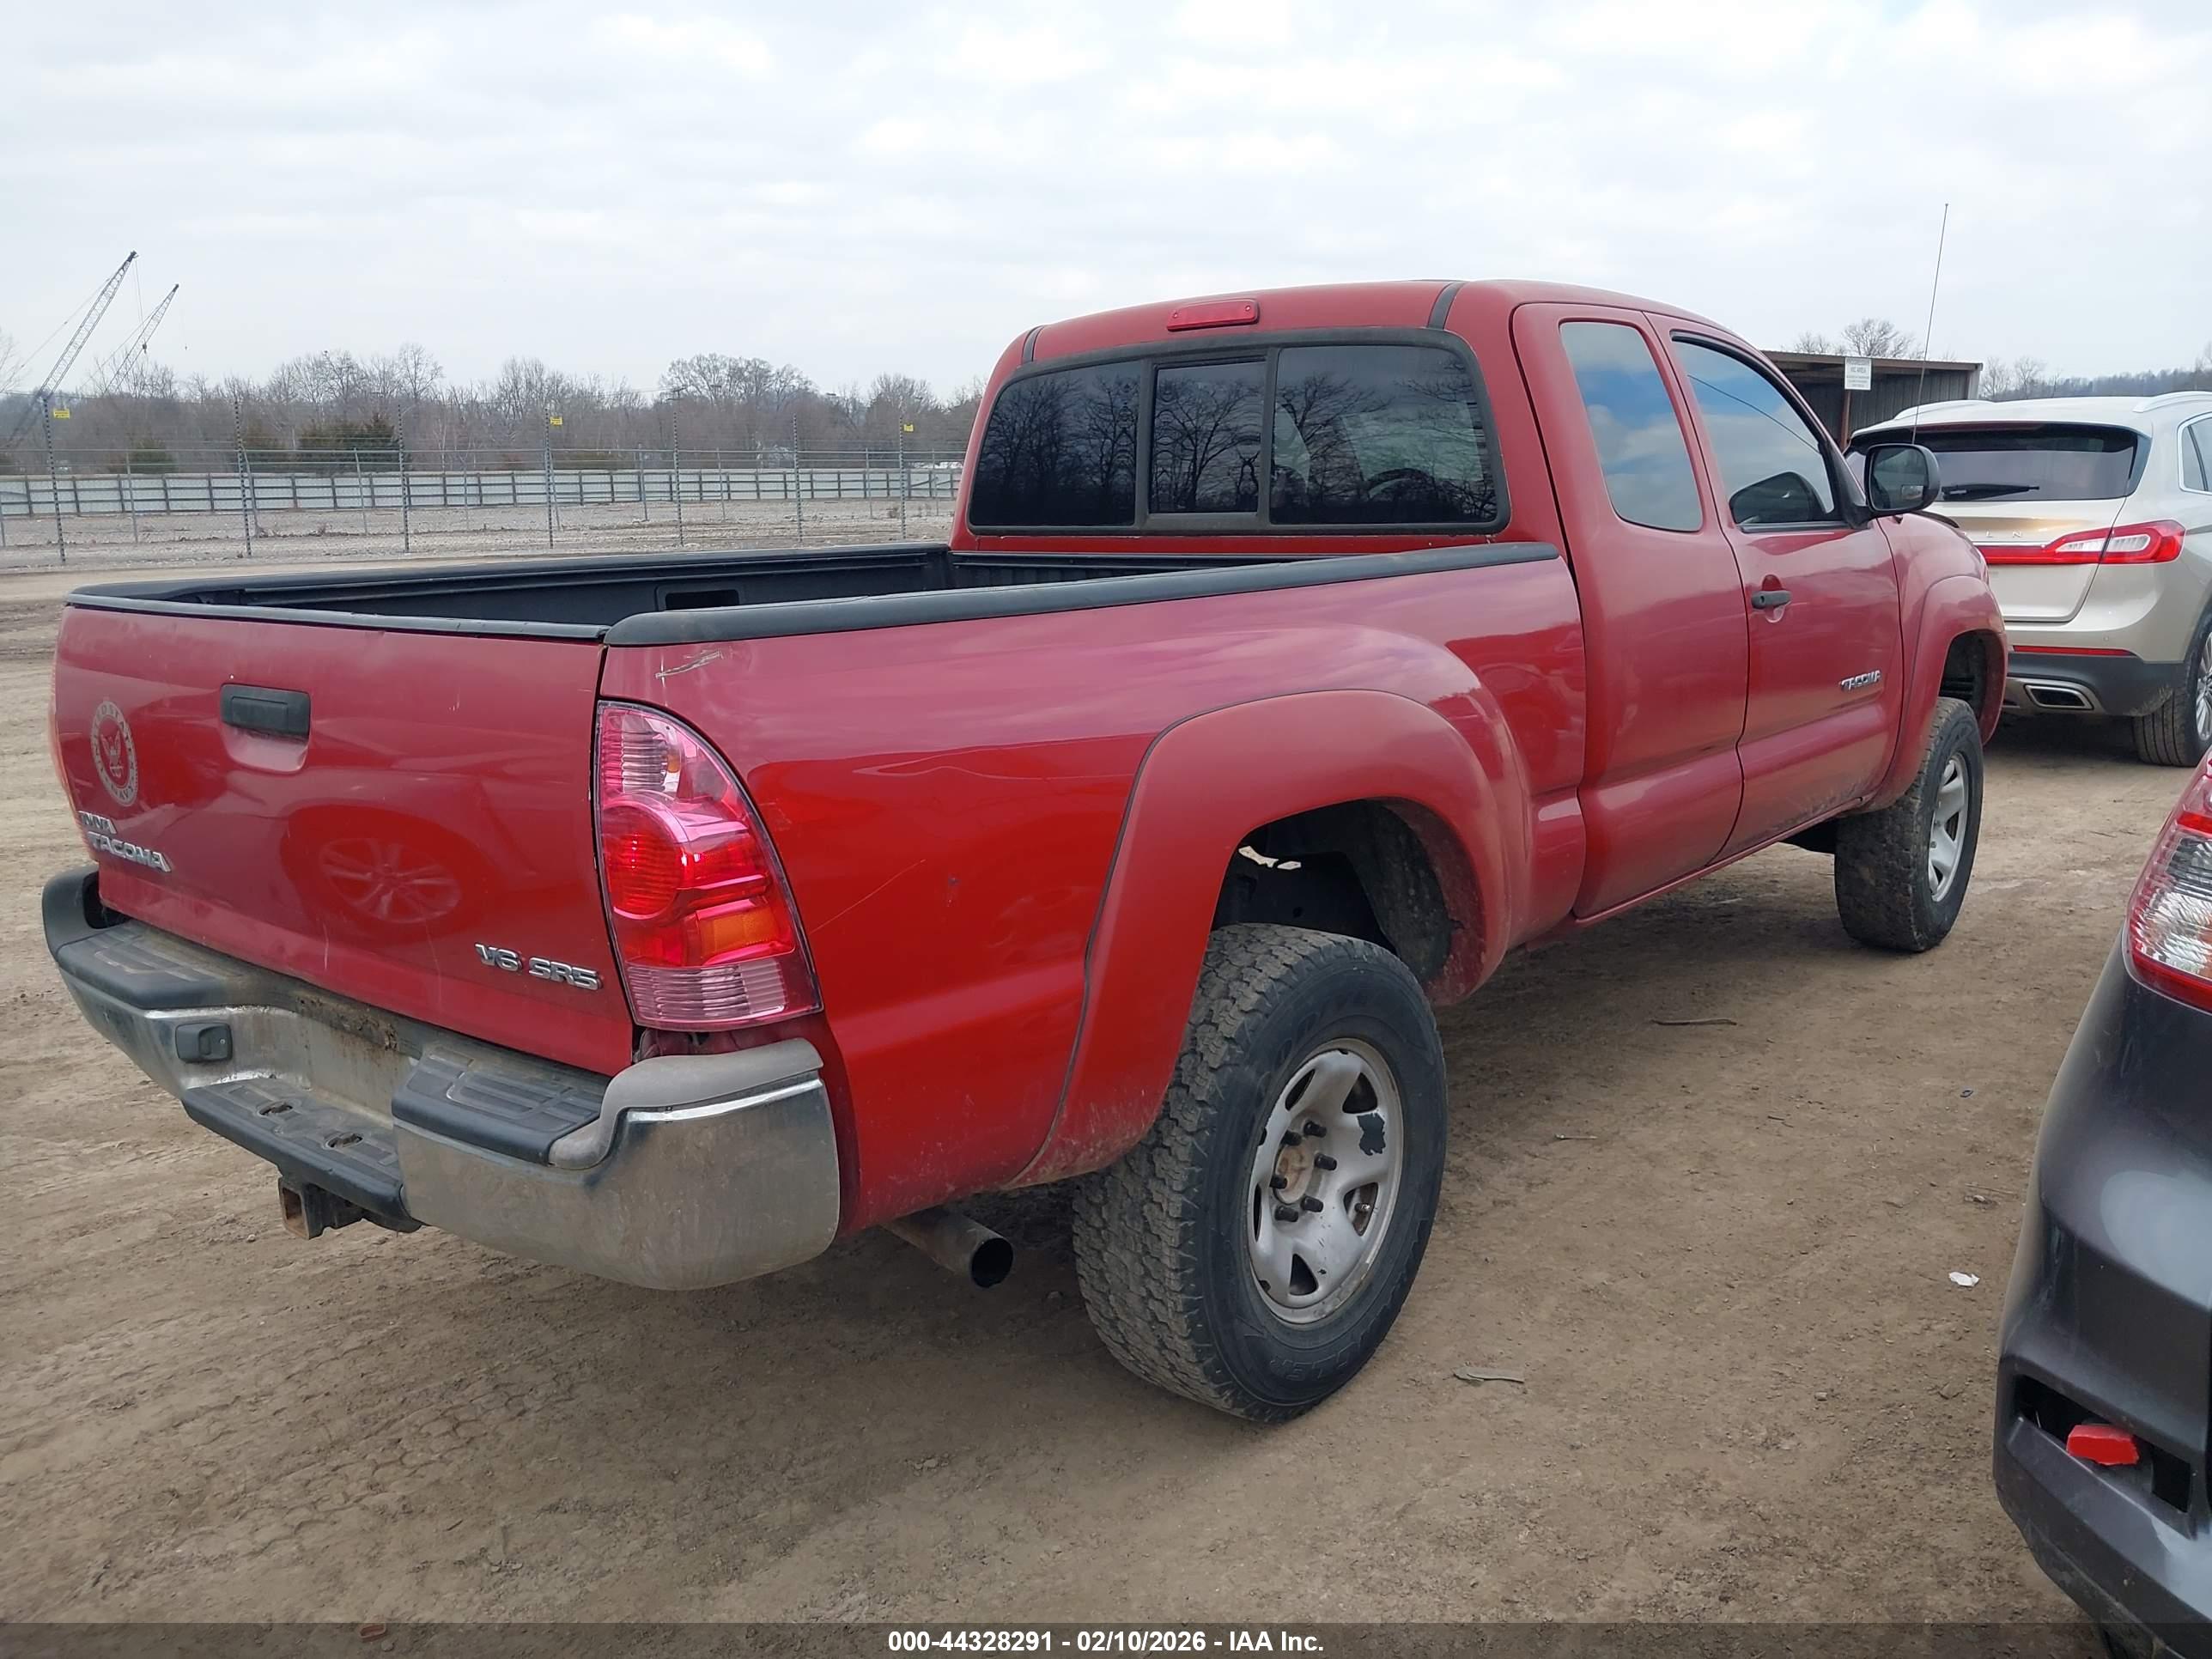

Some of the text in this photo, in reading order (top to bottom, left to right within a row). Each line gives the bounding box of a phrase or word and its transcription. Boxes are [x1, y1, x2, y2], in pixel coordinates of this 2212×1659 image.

[87, 831, 172, 873] TACOMA
[474, 942, 603, 991] V6 SR5
